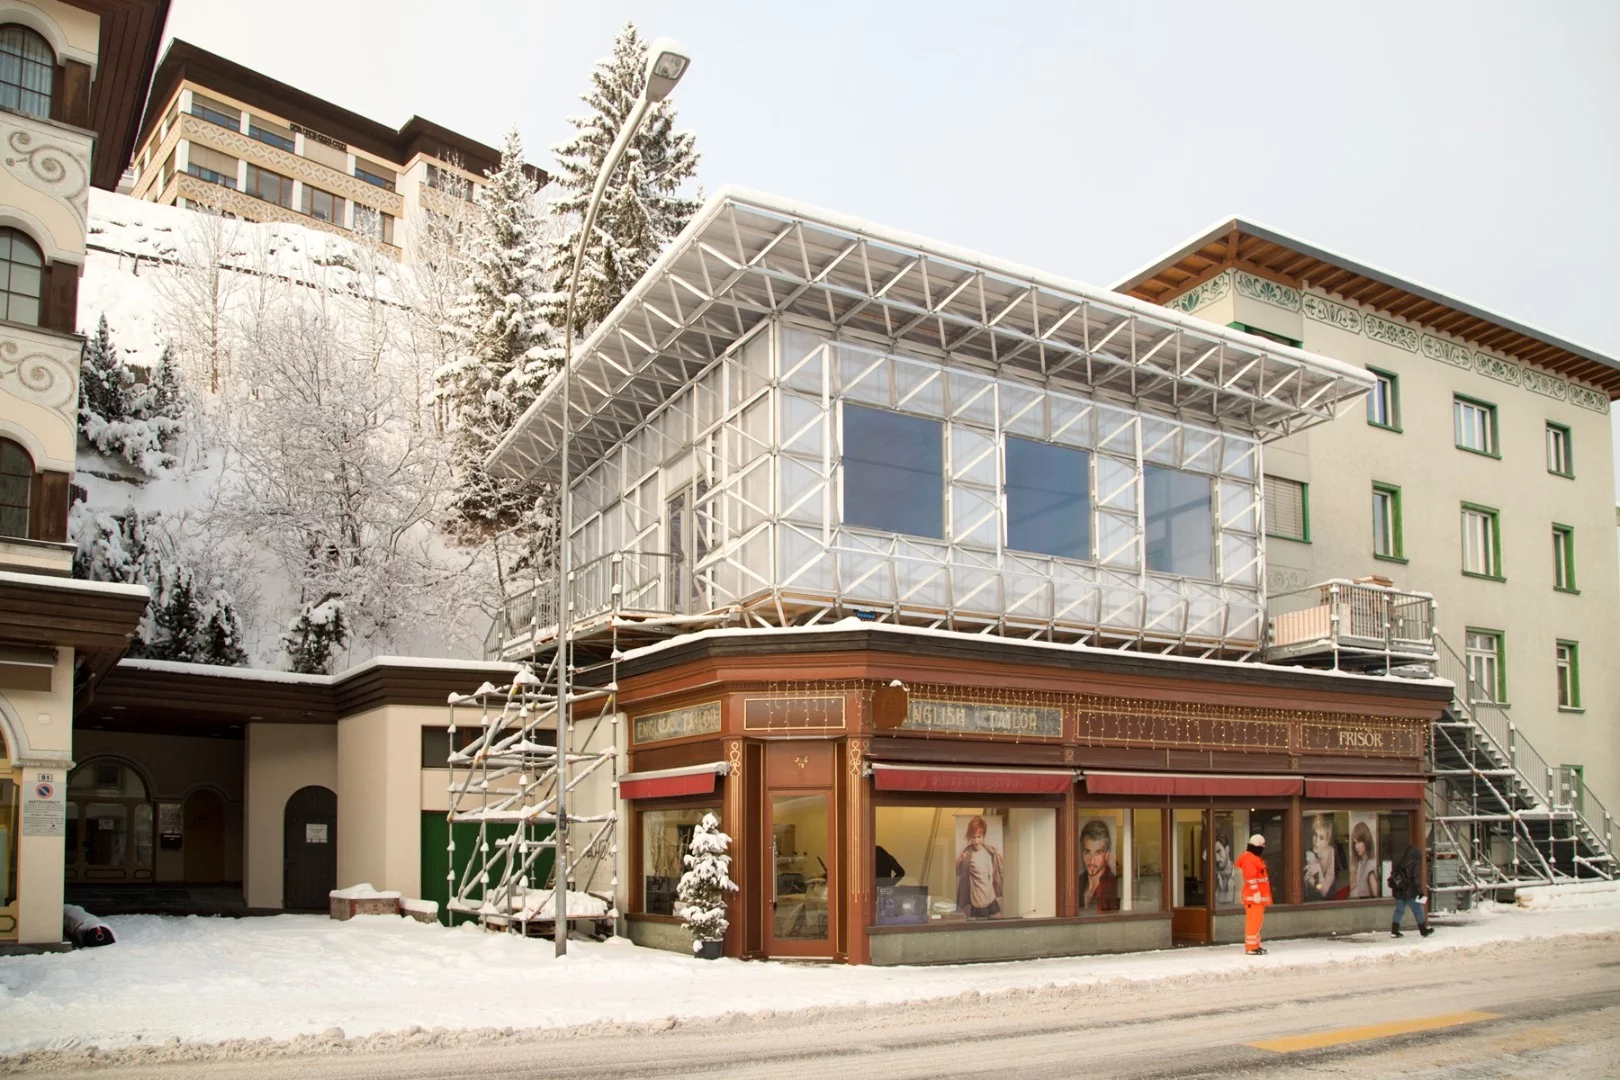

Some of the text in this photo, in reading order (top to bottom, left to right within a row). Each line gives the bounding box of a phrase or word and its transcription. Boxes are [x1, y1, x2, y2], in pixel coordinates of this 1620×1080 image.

[905, 705, 1037, 730] NGLISH TAILOR
[1339, 730, 1382, 747] FRISÖR
